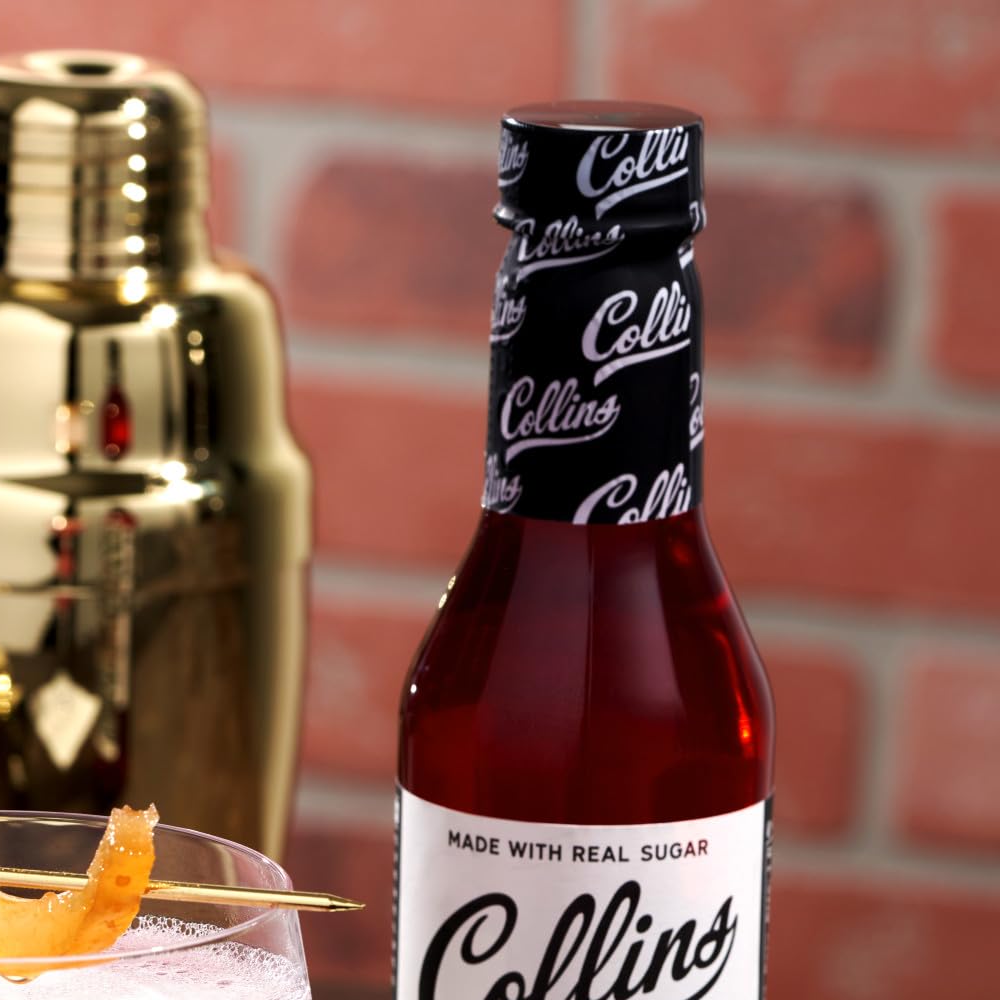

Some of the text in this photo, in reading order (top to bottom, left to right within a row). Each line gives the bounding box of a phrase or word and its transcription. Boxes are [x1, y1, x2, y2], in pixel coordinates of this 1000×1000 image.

[515, 215, 626, 283] Collins
[501, 376, 622, 464] Collins
[448, 830, 709, 863] MADE WITH REAL SUGAR
